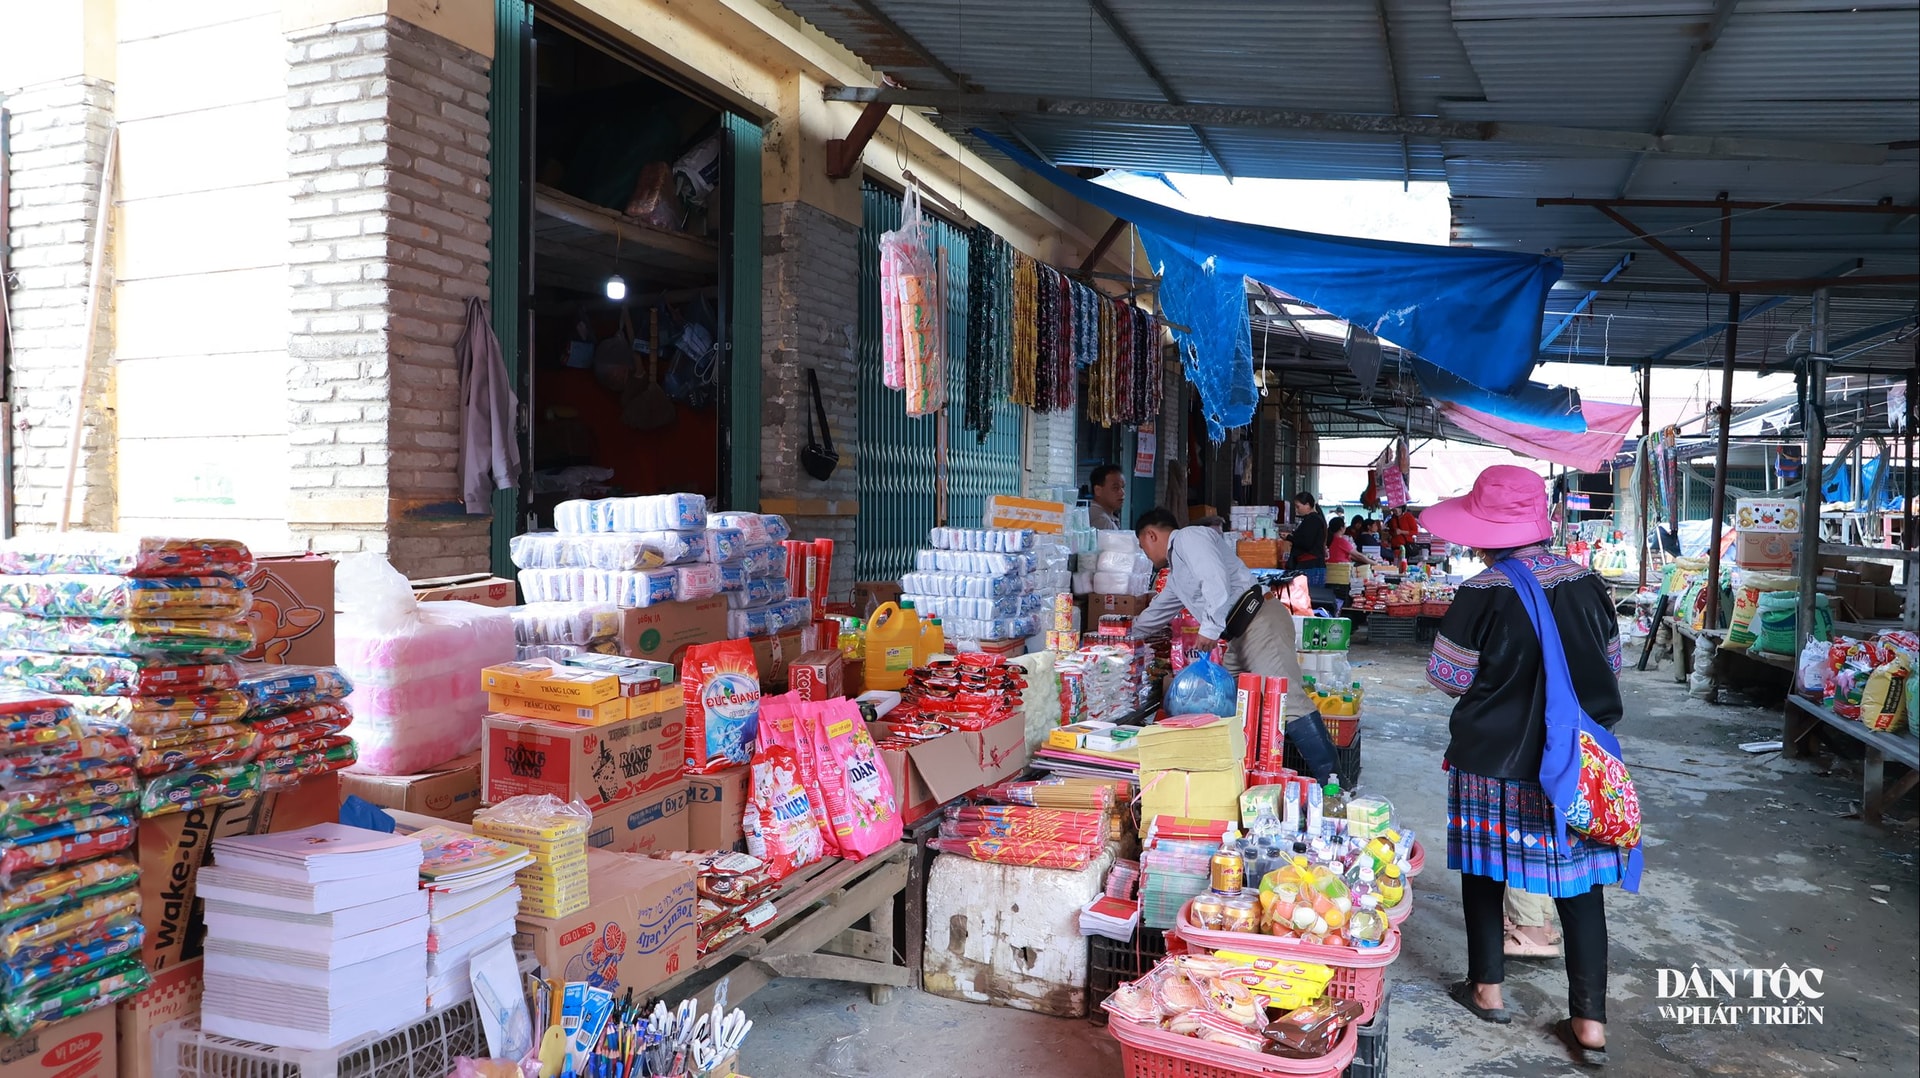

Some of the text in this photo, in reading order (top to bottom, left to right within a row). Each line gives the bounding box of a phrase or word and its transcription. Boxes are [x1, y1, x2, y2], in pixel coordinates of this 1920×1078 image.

[562, 687, 581, 696] LONG
[706, 690, 760, 709] ĐỨC GIANG
[544, 703, 561, 712] LONG
[700, 788, 709, 800] 2
[664, 796, 678, 813] kg
[636, 903, 694, 950] Yogurt Jelly
[572, 929, 581, 940] 10
[56, 1038, 91, 1061] Vị Dâu
